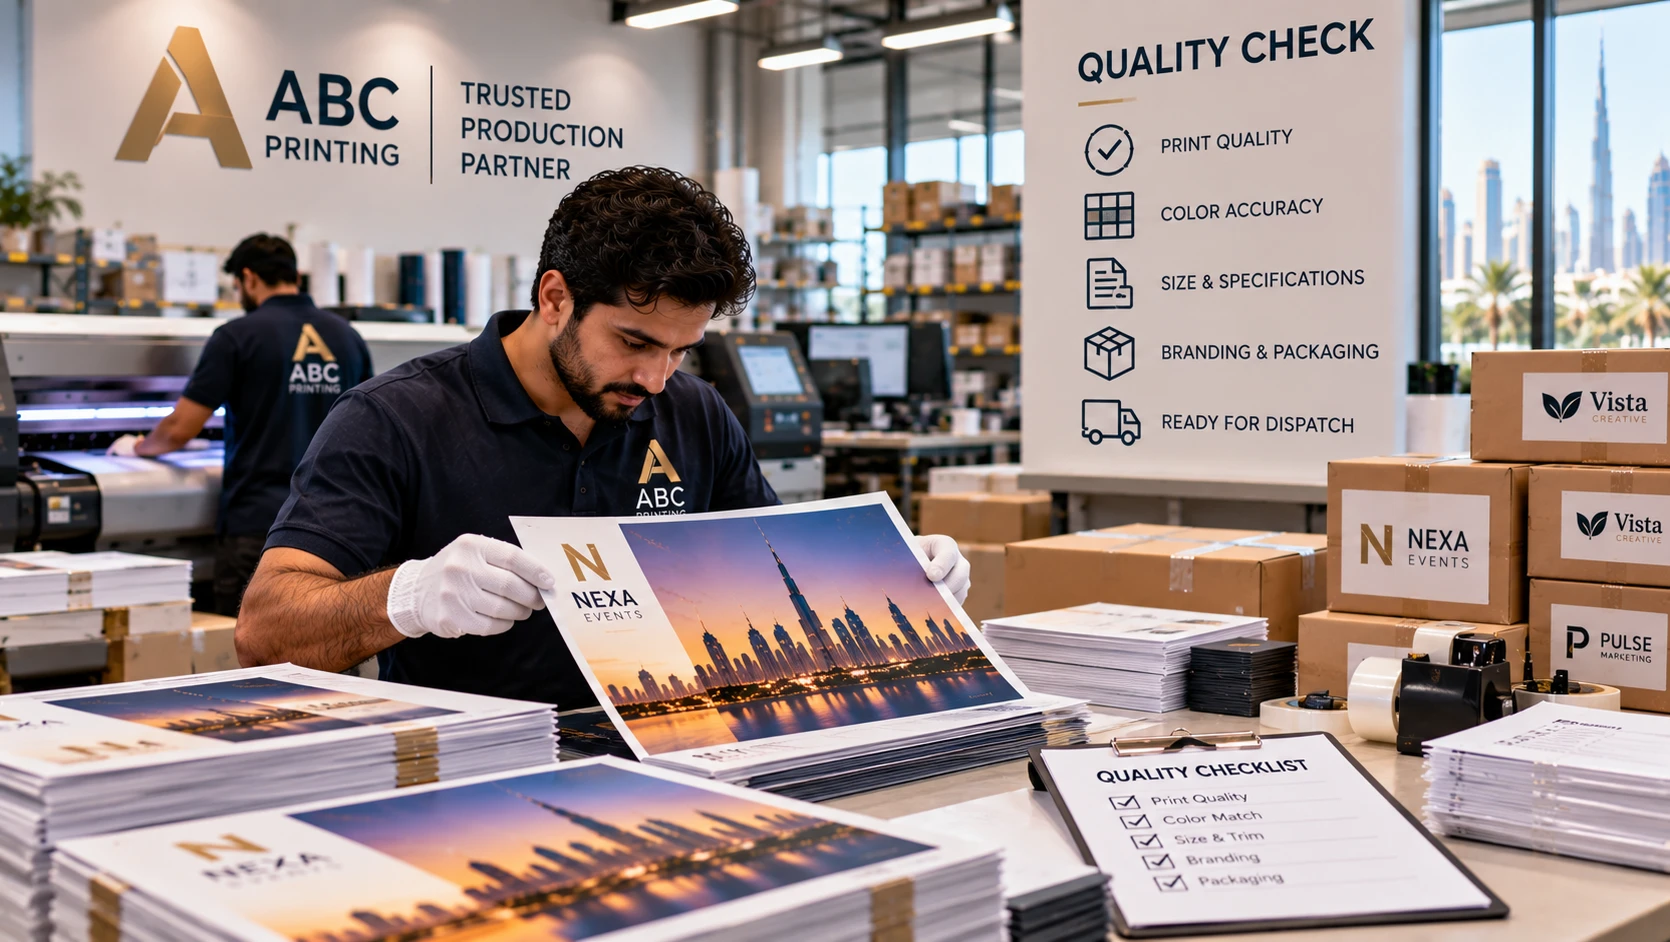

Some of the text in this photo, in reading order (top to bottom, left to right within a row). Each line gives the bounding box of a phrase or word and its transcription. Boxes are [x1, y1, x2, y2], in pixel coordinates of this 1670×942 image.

[1078, 18, 1375, 84] QUALITY CHECK
[266, 69, 400, 131] ABC
[461, 81, 571, 111] TRUSTED
[461, 118, 624, 149] PRODUCTION
[1161, 129, 1293, 154] PRINT QUALITY
[266, 135, 400, 166] PRINTING
[461, 152, 571, 180] PARTNER
[1160, 198, 1324, 222] COLOR ACCURACY
[1161, 269, 1365, 291] SIZE & SPECIFICATIONS
[1161, 344, 1380, 360] BRANDING & PACKAGING
[289, 362, 340, 383] ABC
[288, 384, 341, 394] PRINTING
[1590, 391, 1649, 412] Vista
[1161, 414, 1355, 433] READY FOR DISPATCH
[1592, 415, 1648, 424] CREATIVE
[636, 486, 685, 509] ABC
[1614, 512, 1663, 534] Vista
[1408, 528, 1470, 552] NEXA
[1616, 535, 1662, 544] CREATIVE
[1408, 554, 1469, 569] EVENTS
[571, 589, 638, 609] NEXA
[584, 609, 643, 623] EVENTS
[1600, 632, 1652, 652] PULSE
[1600, 651, 1652, 664] MARKETING
[1096, 759, 1309, 784] QUALITY CHECKLIST
[1151, 791, 1248, 806] Print Quality
[1163, 810, 1263, 825] Color Match
[1174, 830, 1265, 845] Size & Trim
[1186, 852, 1261, 866] Branding
[1198, 871, 1285, 887] Packaging
